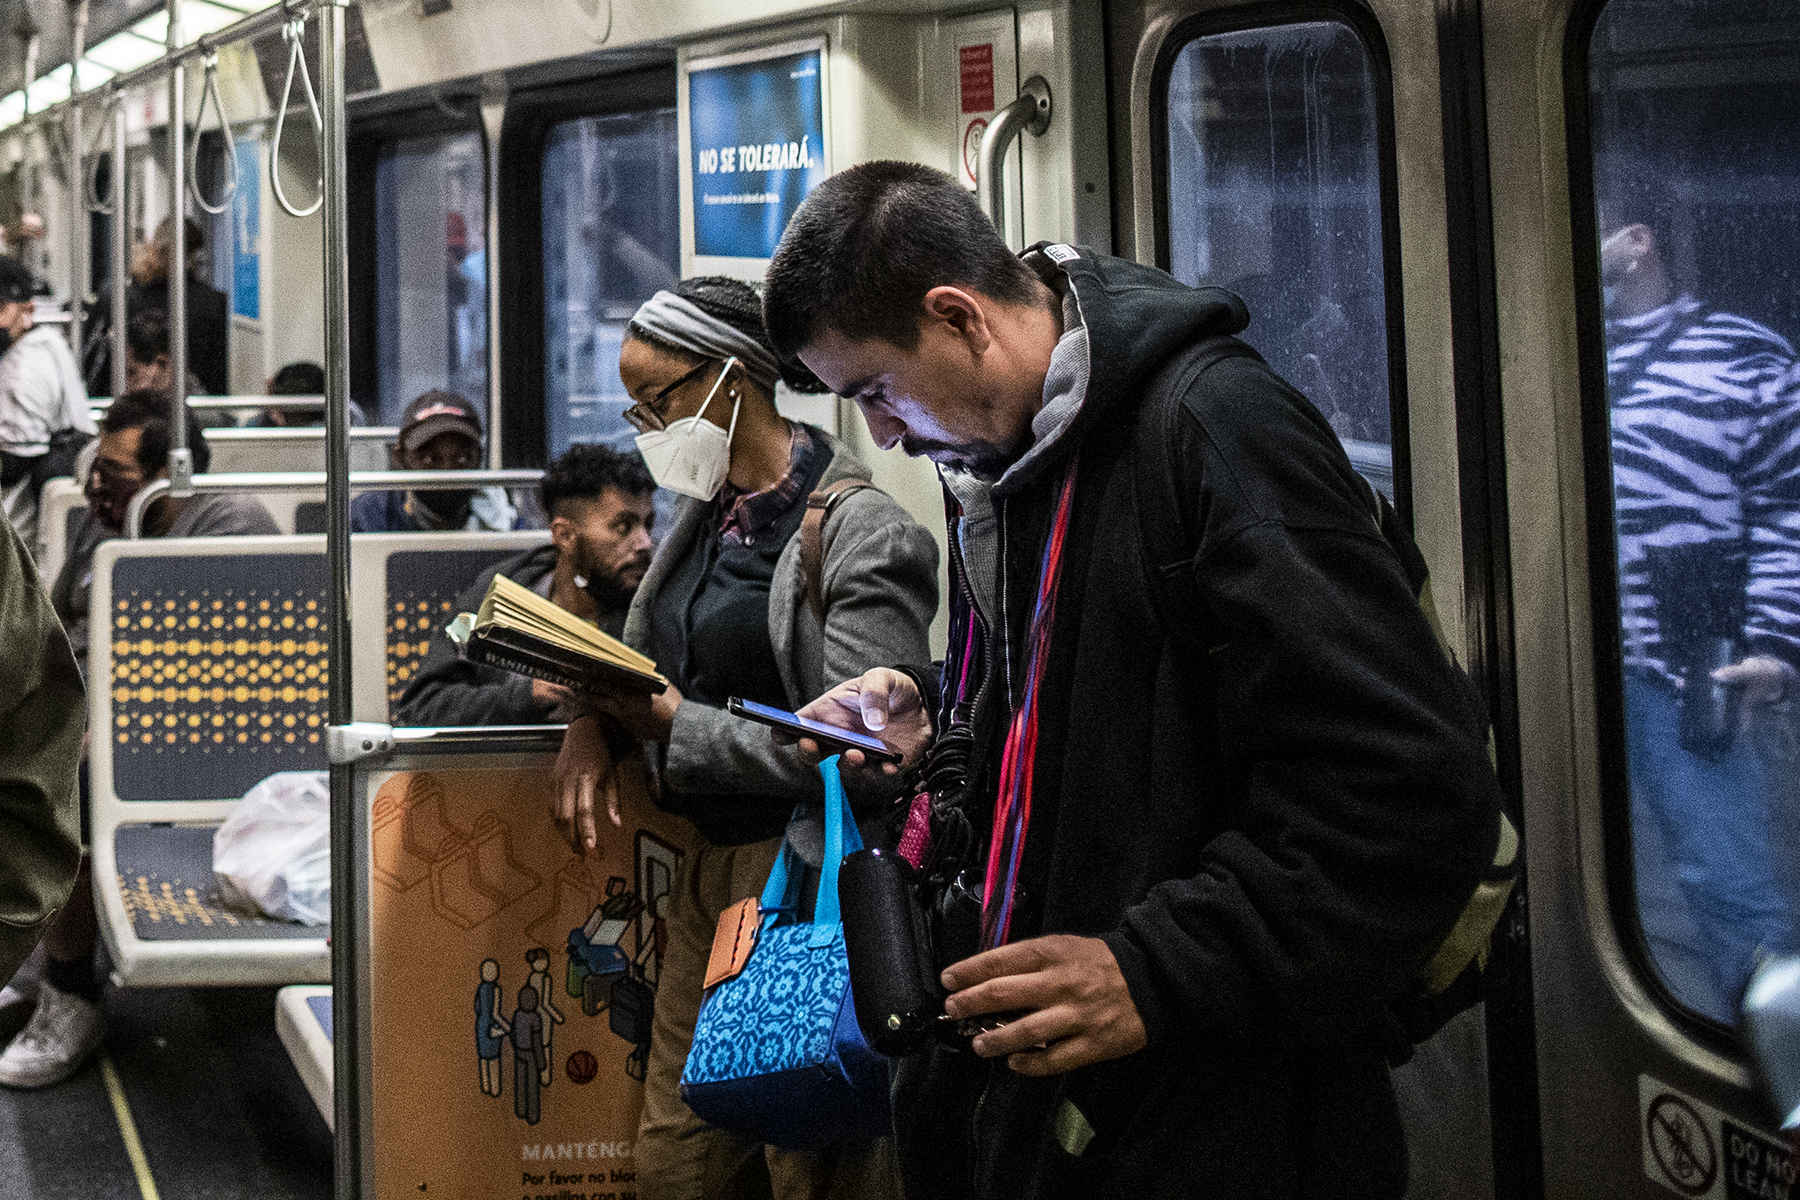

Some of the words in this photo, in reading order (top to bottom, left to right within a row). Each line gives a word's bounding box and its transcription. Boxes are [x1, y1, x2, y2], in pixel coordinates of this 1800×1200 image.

[699, 147, 718, 174] NO
[720, 146, 736, 174] SE
[738, 134, 815, 172] TOLERARÁ.
[485, 652, 582, 686] WASHINGTON
[521, 1139, 632, 1160] MANTÉNG
[1766, 1148, 1795, 1184] NO
[522, 1171, 545, 1185] Por
[549, 1169, 583, 1185] favor
[588, 1173, 606, 1184] no
